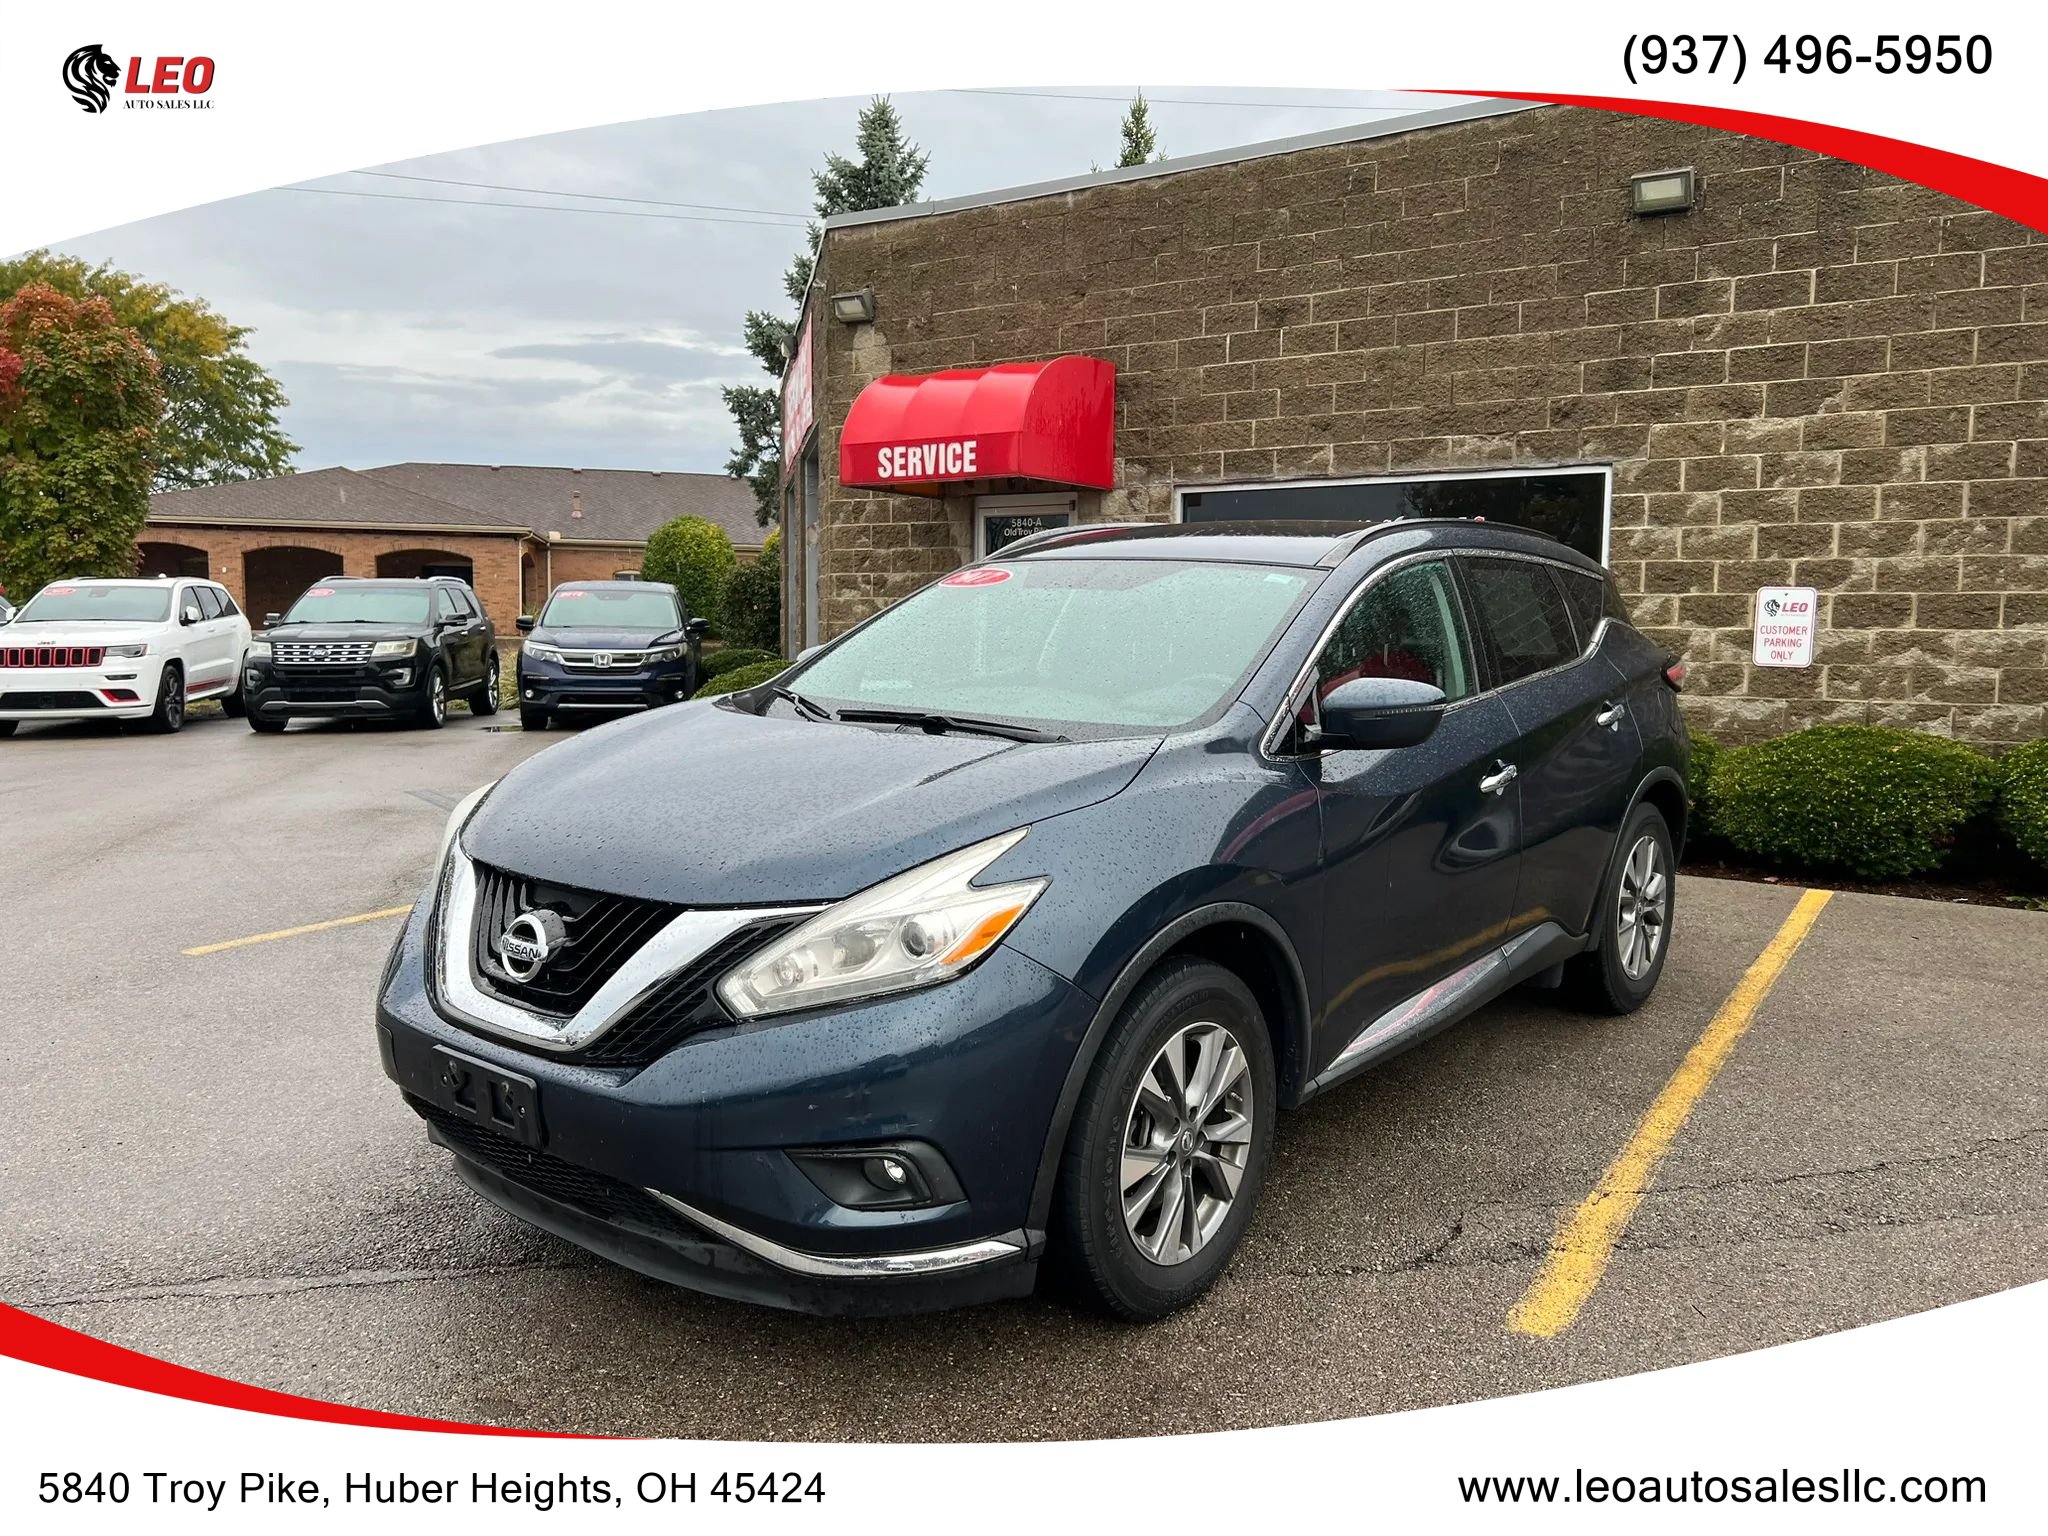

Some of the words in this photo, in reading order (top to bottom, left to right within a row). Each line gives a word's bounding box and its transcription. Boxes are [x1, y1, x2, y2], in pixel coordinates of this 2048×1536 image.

[877, 440, 977, 479] SERVICE
[1011, 518, 1042, 527] 5840-A
[1004, 528, 1017, 537] Old
[1781, 602, 1809, 613] LEO
[1760, 625, 1808, 636] CUSTOMER
[1763, 637, 1802, 648] PARKING
[1770, 650, 1794, 660] ONLY
[502, 937, 539, 959] NISSAN
